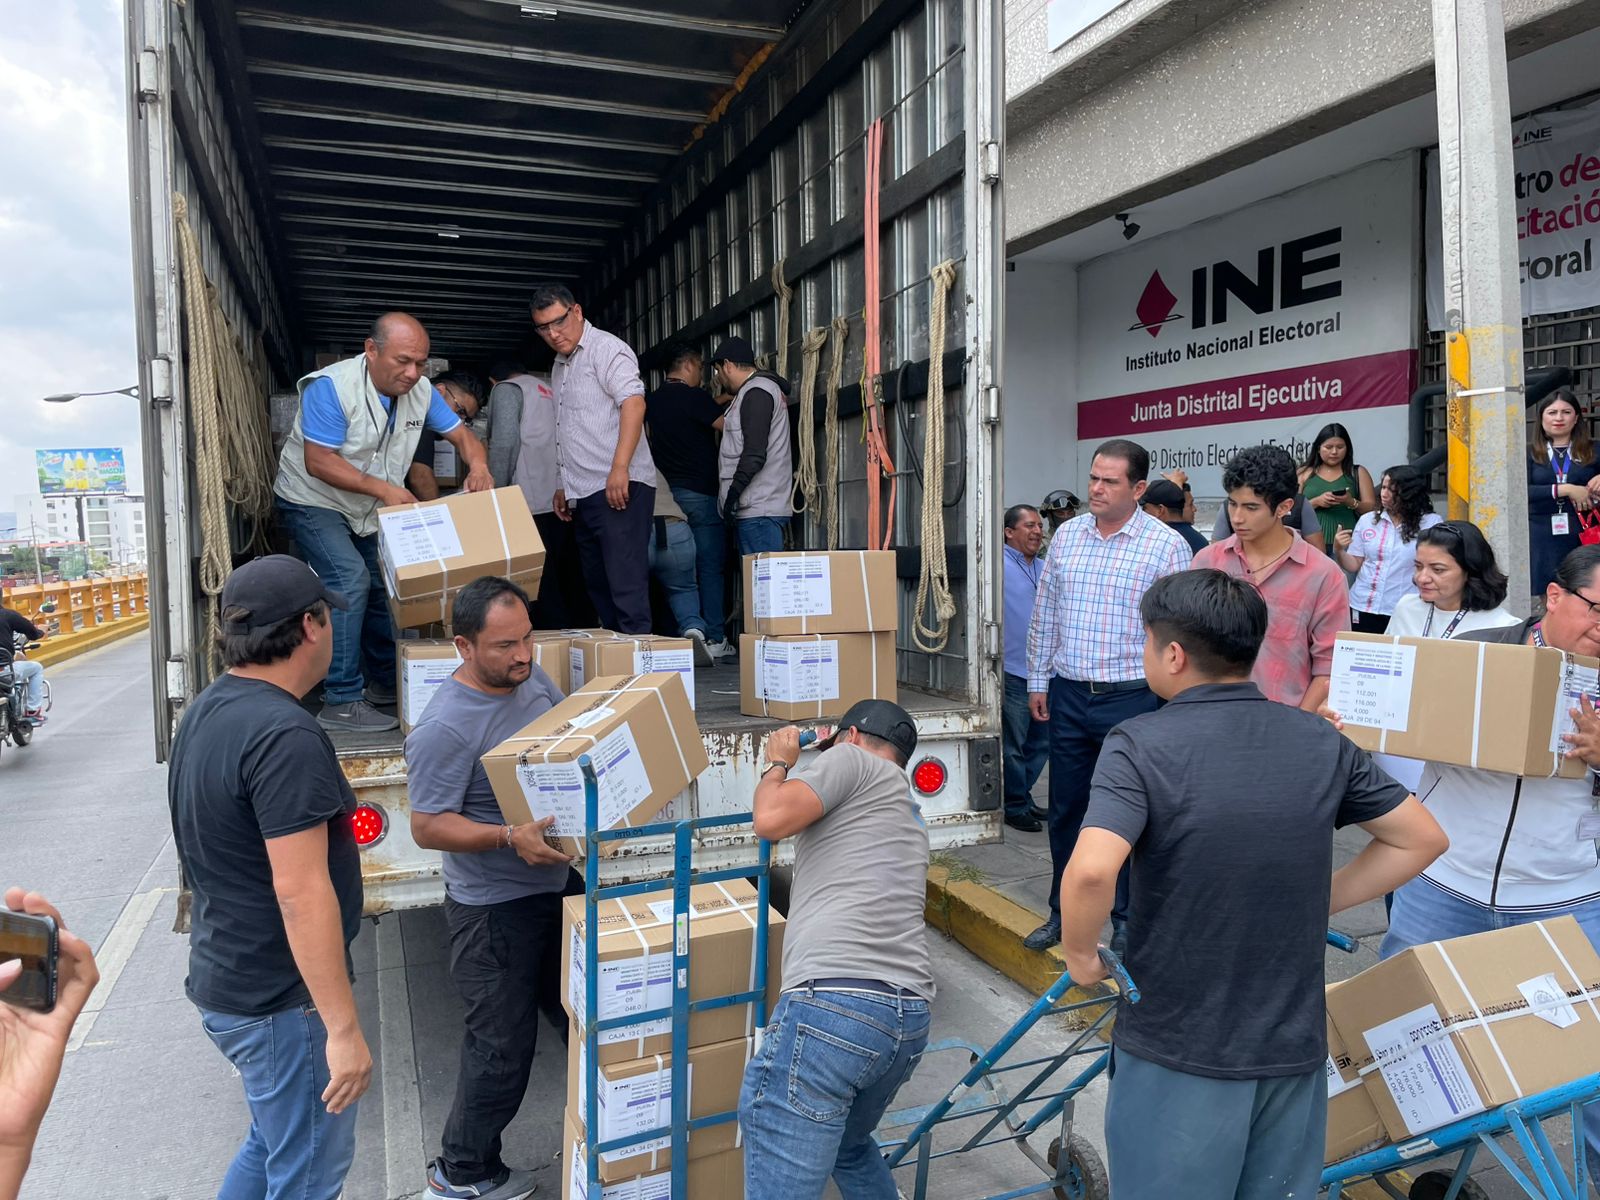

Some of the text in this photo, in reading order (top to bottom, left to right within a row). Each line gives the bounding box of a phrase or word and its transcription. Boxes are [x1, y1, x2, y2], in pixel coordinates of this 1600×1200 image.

[1524, 126, 1552, 142] INE
[1560, 153, 1600, 187] de
[1192, 227, 1342, 329] INE
[1126, 312, 1341, 371] Instituto Nacional Electoral
[1131, 377, 1342, 423] Junta Distrital Ejecutiva
[1161, 448, 1203, 470] Distrito
[609, 1032, 625, 1040] CAJA
[620, 1146, 636, 1156] CAJA
